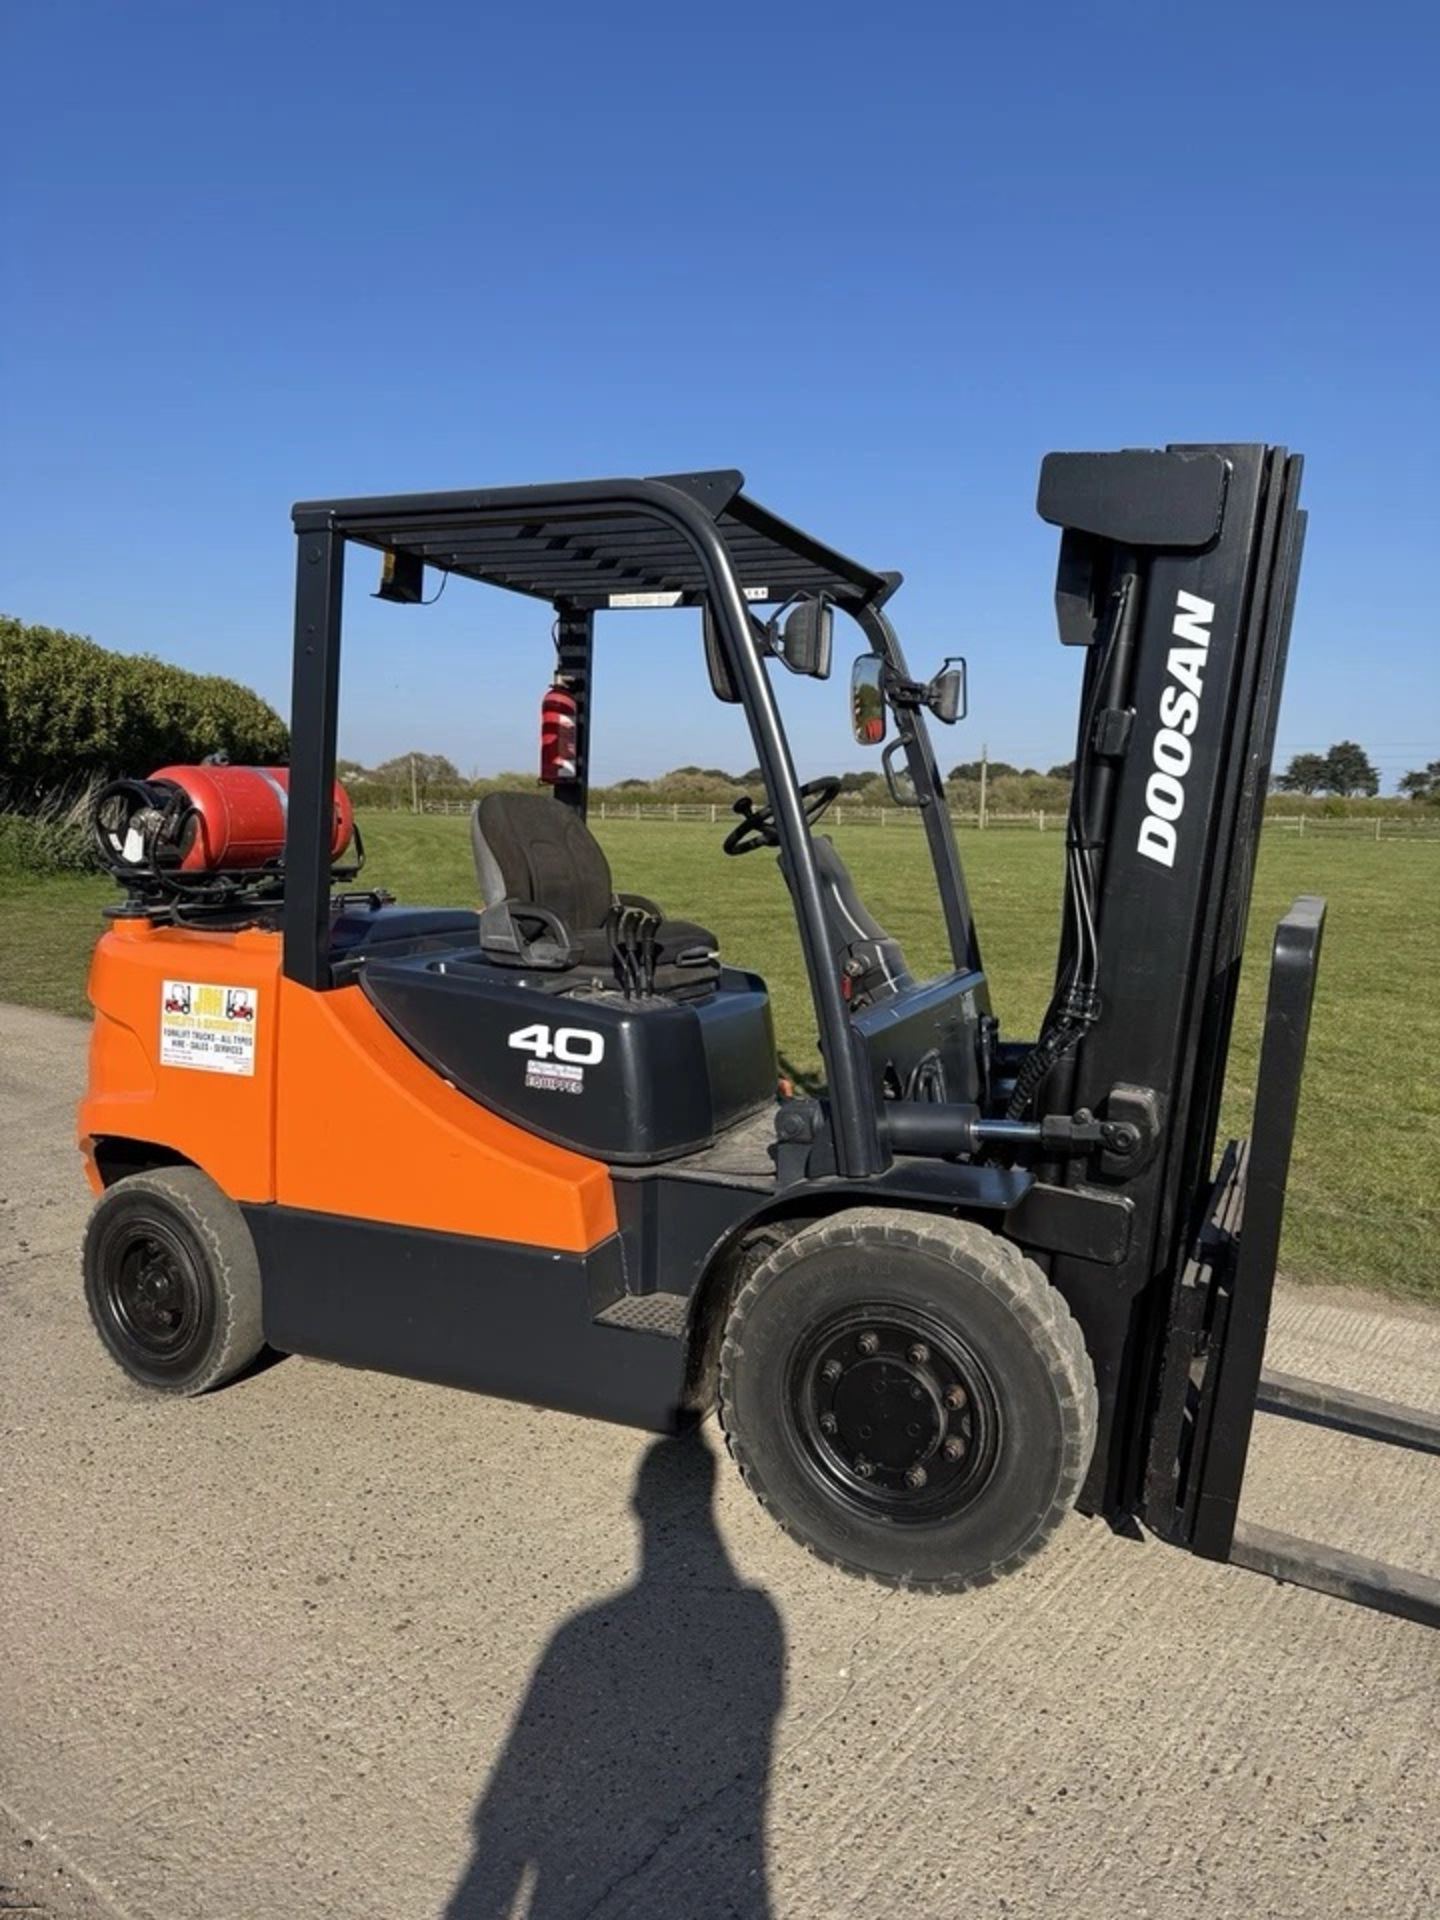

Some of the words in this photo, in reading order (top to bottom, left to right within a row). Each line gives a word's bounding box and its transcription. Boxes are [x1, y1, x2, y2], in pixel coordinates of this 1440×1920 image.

[1137, 589, 1215, 868] DOOSAN
[172, 1039, 184, 1048] HIRE
[191, 1041, 209, 1051] SALES
[192, 1031, 215, 1042] TRUCKS
[221, 1035, 232, 1044] ALL
[234, 1036, 253, 1046] TYPES
[508, 1024, 605, 1065] 40
